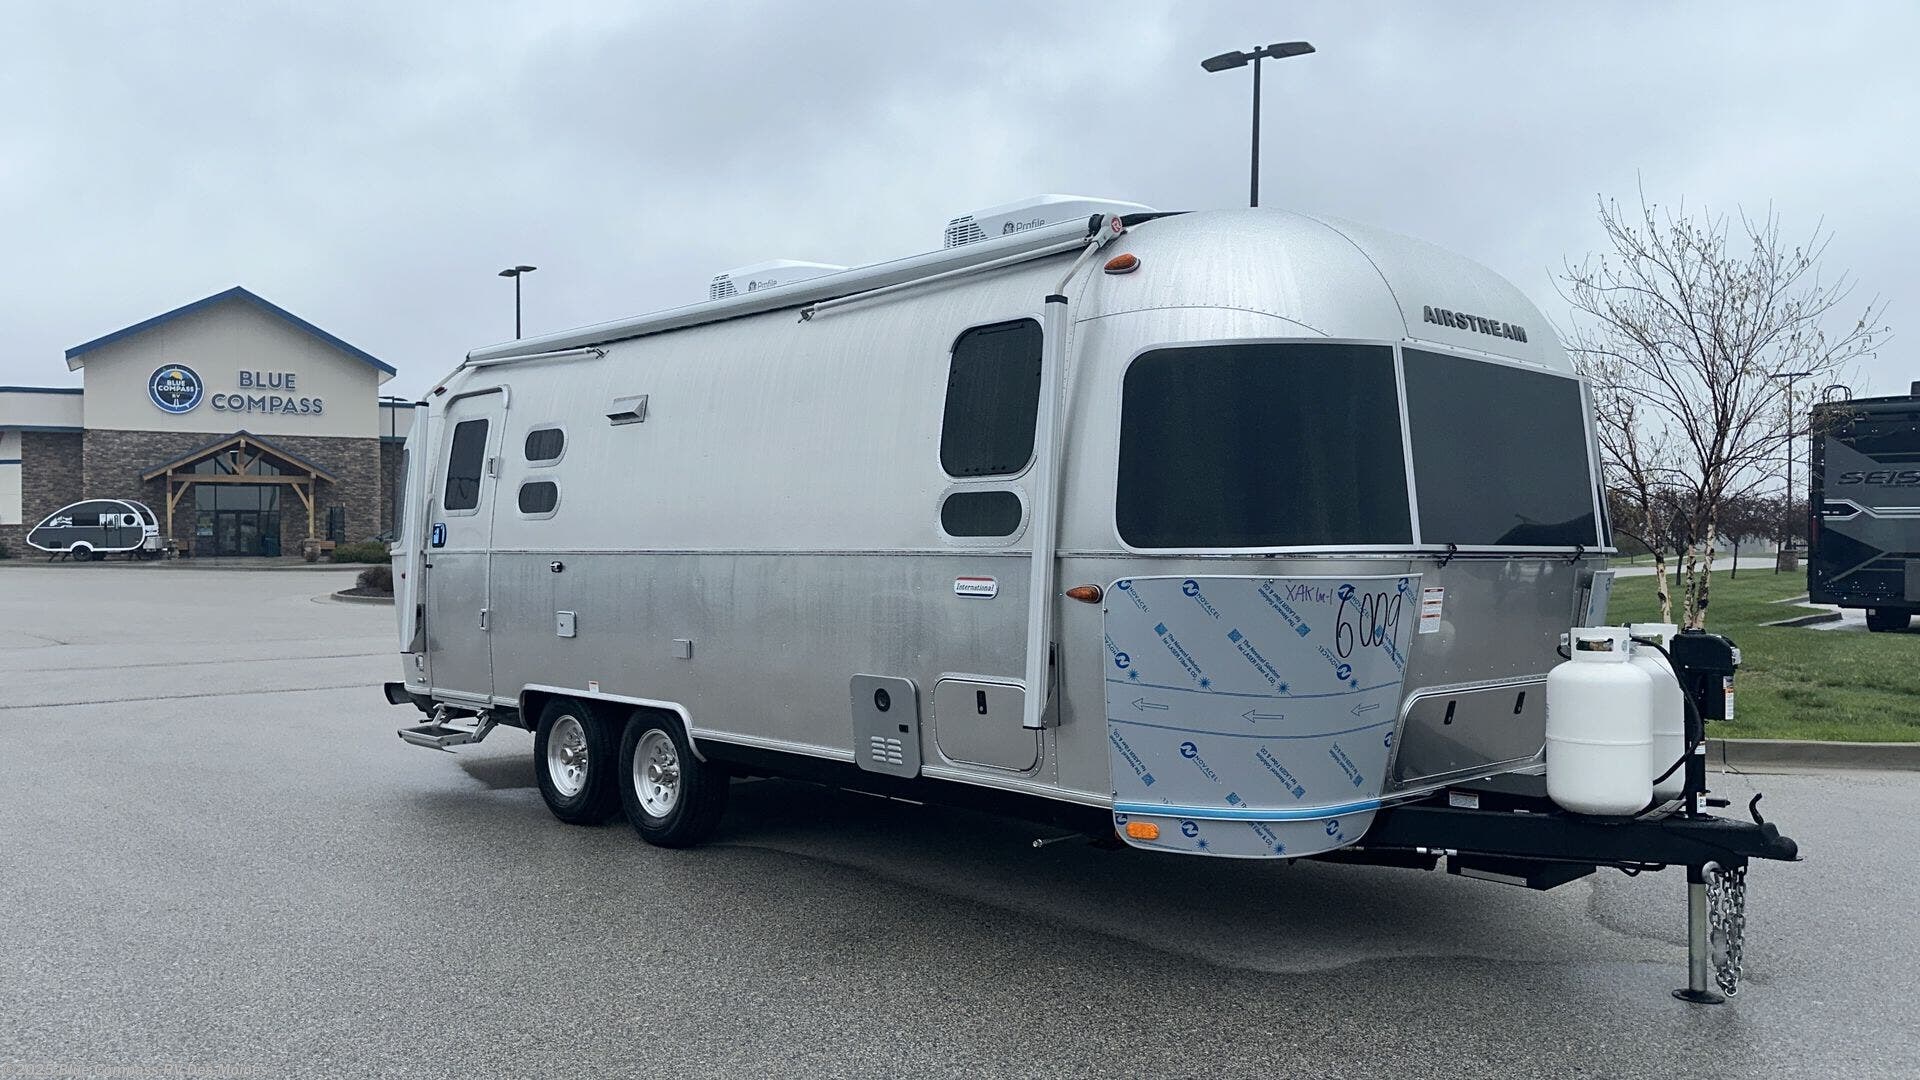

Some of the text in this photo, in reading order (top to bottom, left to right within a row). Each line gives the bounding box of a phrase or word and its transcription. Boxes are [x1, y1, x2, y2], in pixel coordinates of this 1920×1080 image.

[1016, 218, 1046, 231] Profile
[1423, 305, 1528, 343] AIRSTREAM
[158, 385, 195, 393] COMPASS
[239, 370, 296, 389] BLUE
[211, 393, 323, 415] COMPASS
[1126, 586, 1149, 613] NOVACEL
[1195, 591, 1221, 619] NOVACEL
[1336, 586, 1403, 661] 6009
[1316, 644, 1340, 668] NOVACEL
[1194, 754, 1218, 782] NOVACEL
